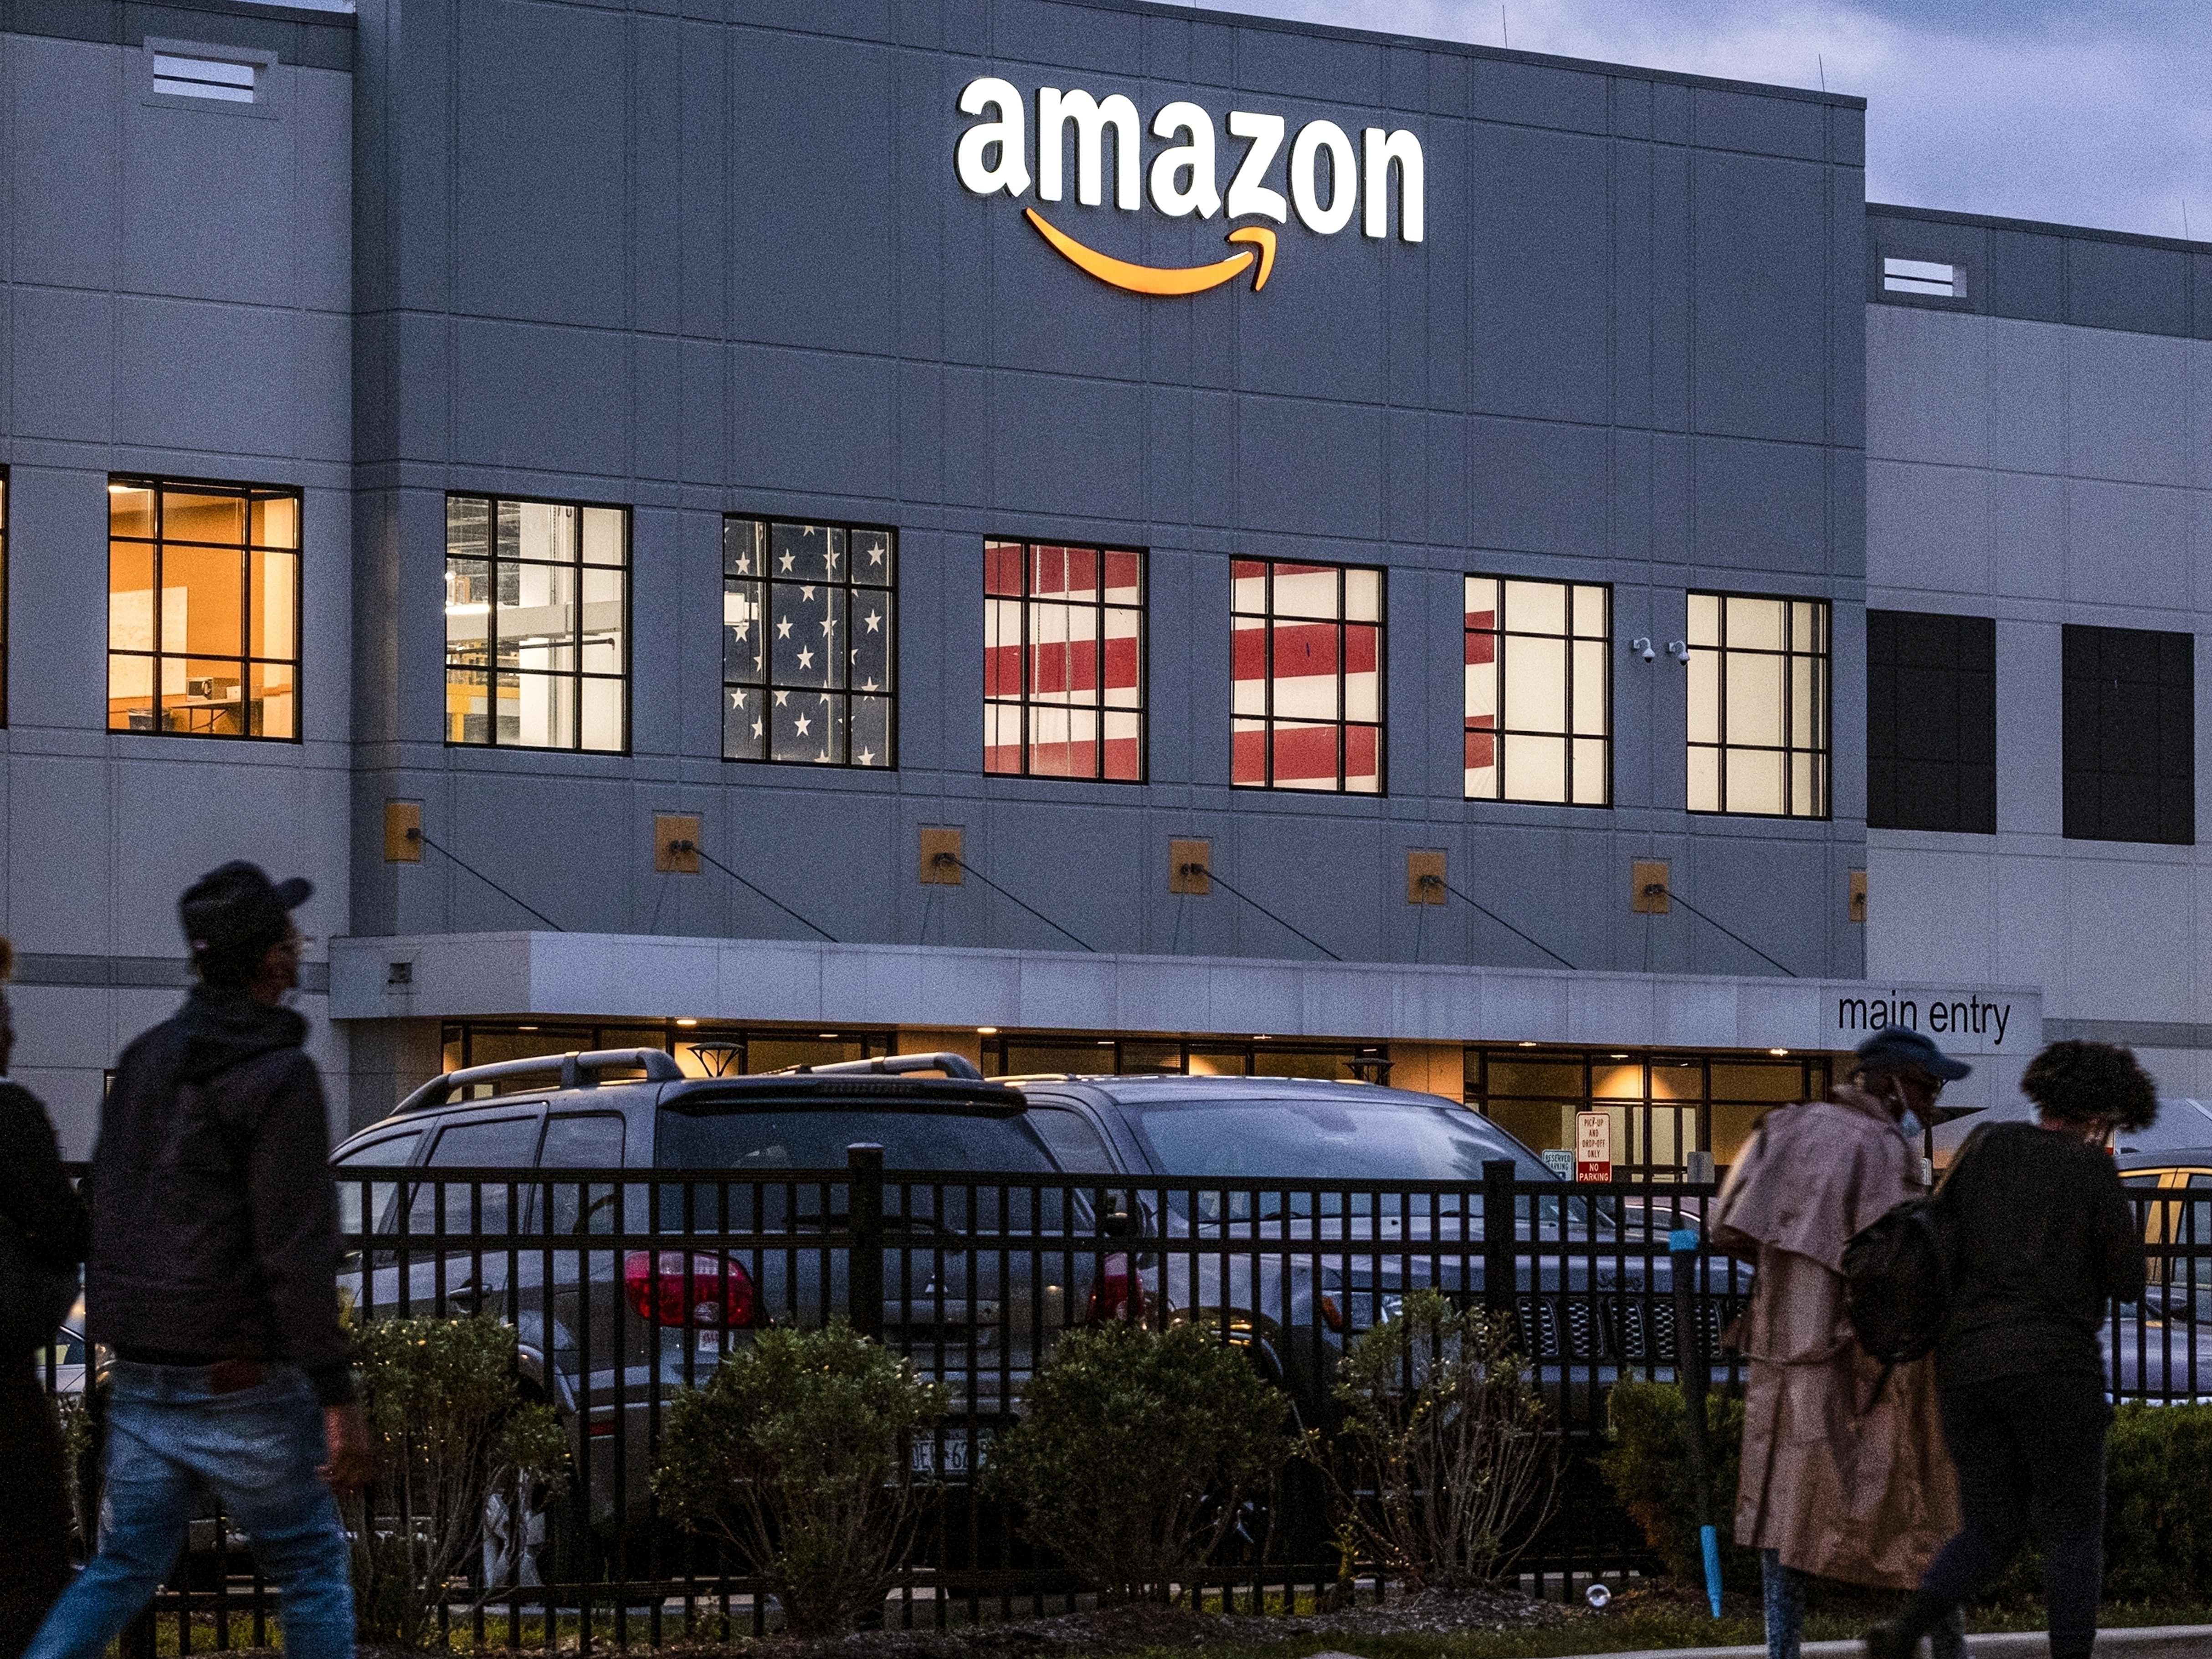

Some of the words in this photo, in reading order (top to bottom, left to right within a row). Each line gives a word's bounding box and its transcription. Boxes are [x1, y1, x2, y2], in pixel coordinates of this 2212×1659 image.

[955, 76, 1425, 242] amazon
[1839, 990, 1917, 1031] main
[1930, 994, 2011, 1045] entry
[1584, 1119, 1603, 1127] PICK-UP
[1545, 1154, 1570, 1162] RESERVED
[1589, 1163, 1599, 1171] NO
